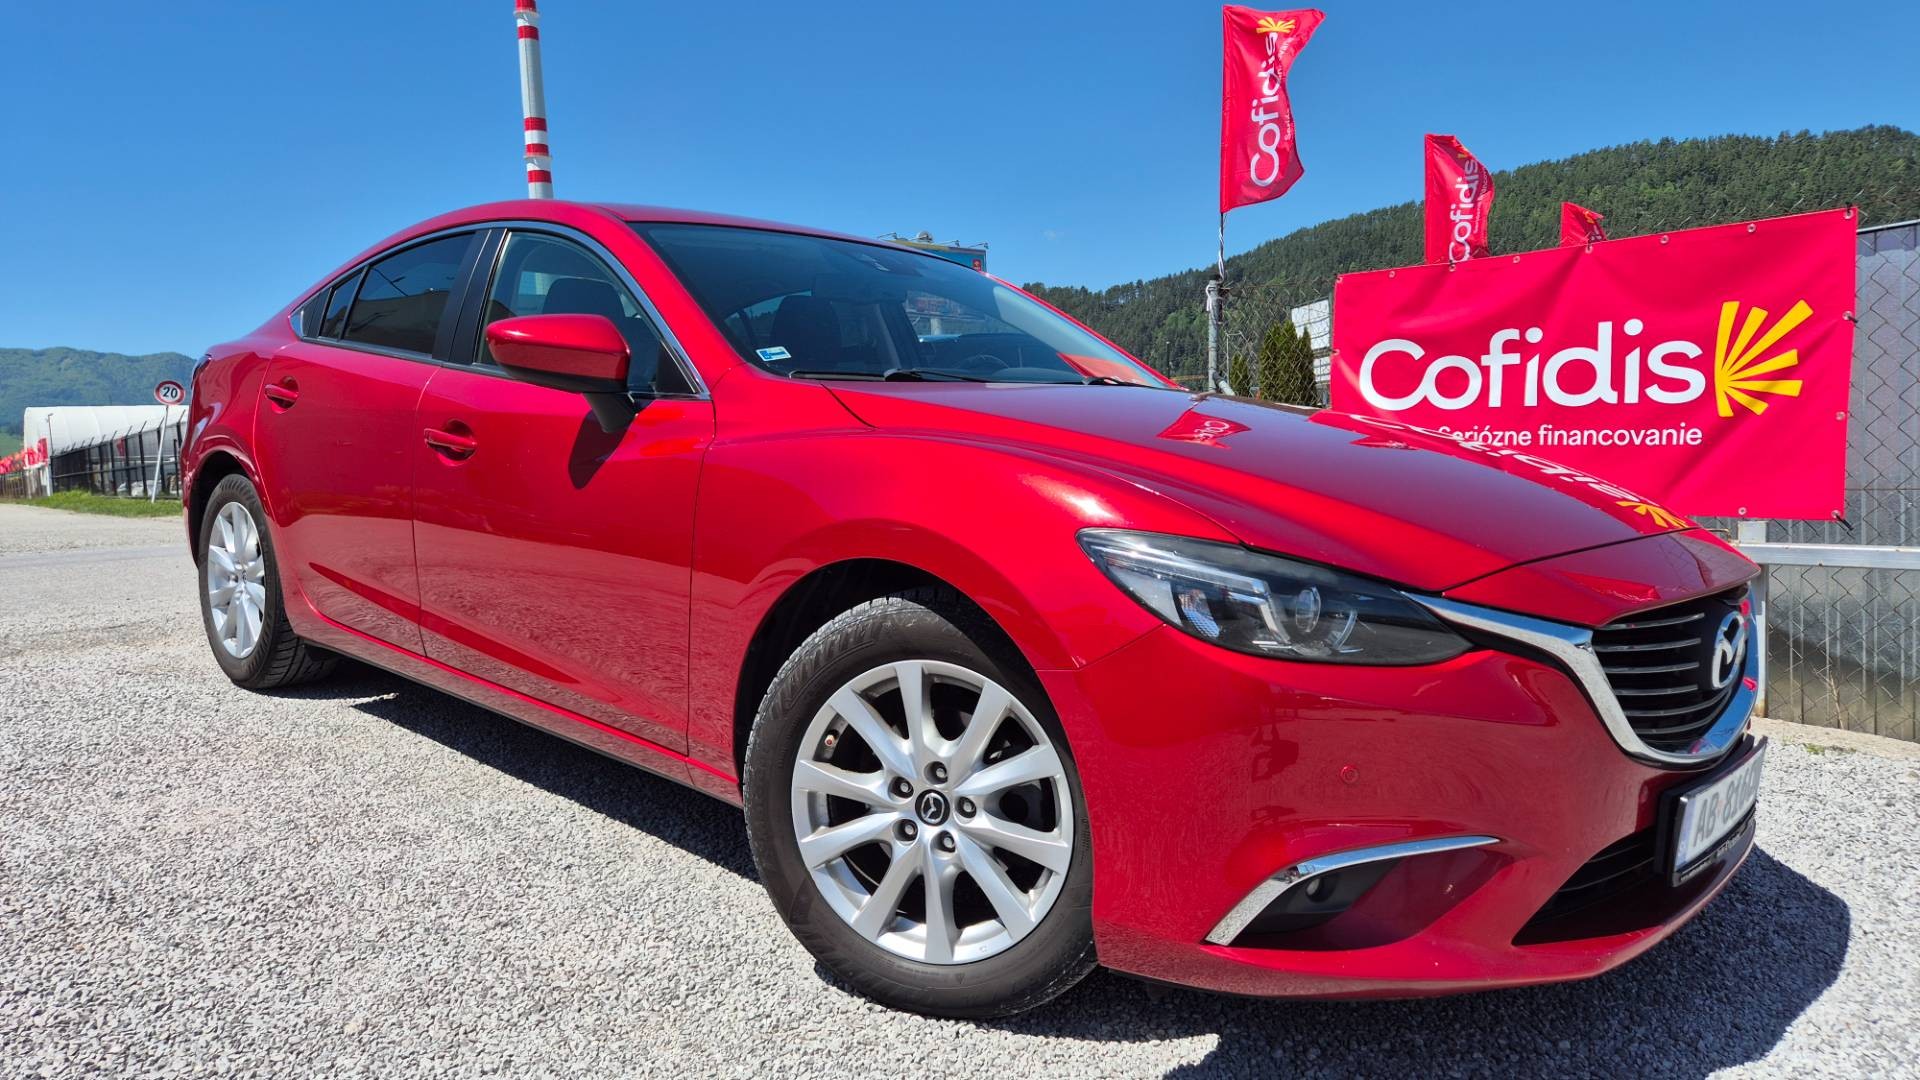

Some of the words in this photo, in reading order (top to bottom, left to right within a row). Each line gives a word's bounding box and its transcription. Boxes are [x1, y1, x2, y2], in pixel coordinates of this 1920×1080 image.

[1250, 31, 1281, 187] Cofidis
[1449, 159, 1479, 263] Cofidis
[163, 386, 178, 399] 20
[1359, 318, 1706, 411] Cofidis
[1538, 422, 1702, 447] financovanie
